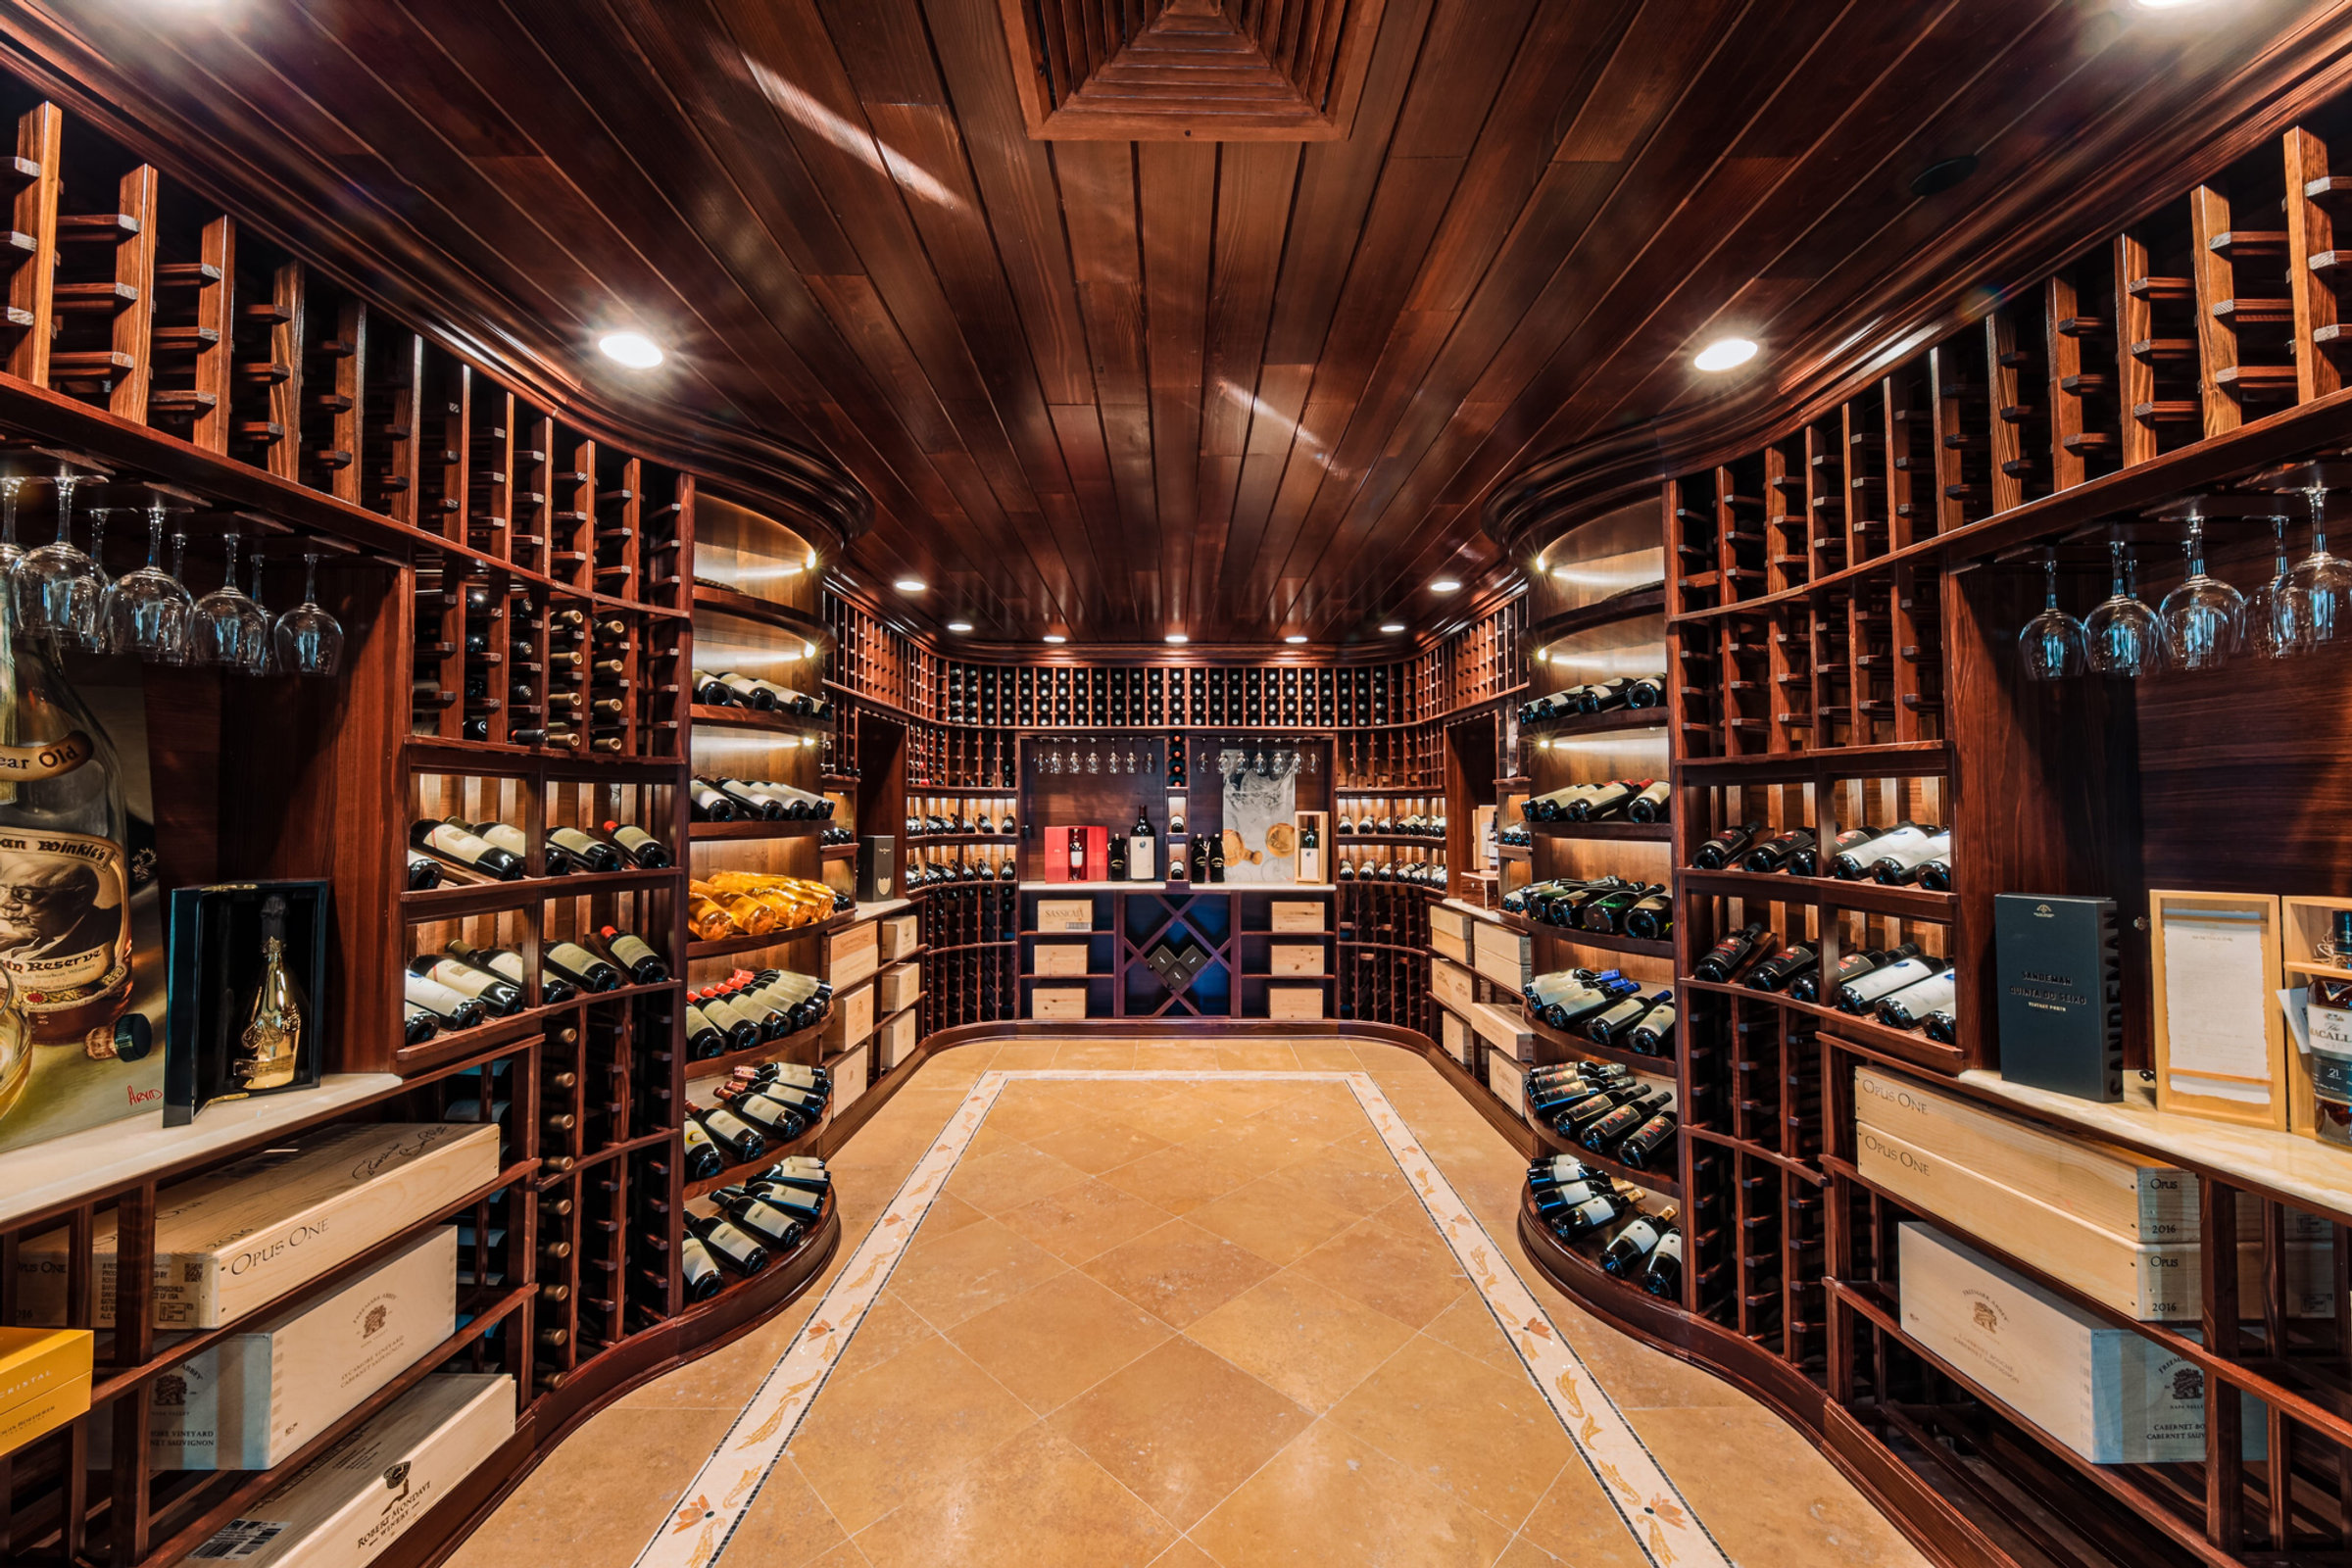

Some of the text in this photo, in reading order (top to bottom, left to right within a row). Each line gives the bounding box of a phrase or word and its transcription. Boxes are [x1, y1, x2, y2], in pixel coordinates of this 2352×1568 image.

[0, 745, 78, 769] ear Old
[0, 838, 26, 850] an
[26, 949, 102, 972] Reserve
[2022, 971, 2073, 986] SANDEMAN
[2310, 1026, 2352, 1043] MACALL
[2328, 1068, 2340, 1077] 21
[1862, 1079, 1929, 1115] OPUS ONE
[1865, 1135, 1931, 1177] OPUS ONE
[2150, 1178, 2179, 1190] OPUS
[2152, 1224, 2177, 1234] 2016
[231, 1218, 330, 1276] OPUS ONE
[17, 1261, 67, 1273] PUS ONE
[2150, 1255, 2179, 1267] OPUS
[2152, 1302, 2177, 1312] 2016
[2153, 1423, 2192, 1432] CABERNET
[2146, 1432, 2185, 1441] CABERNET
[358, 1480, 431, 1549] ROBERT MONDAVI
[380, 1509, 409, 1537] WINERY
